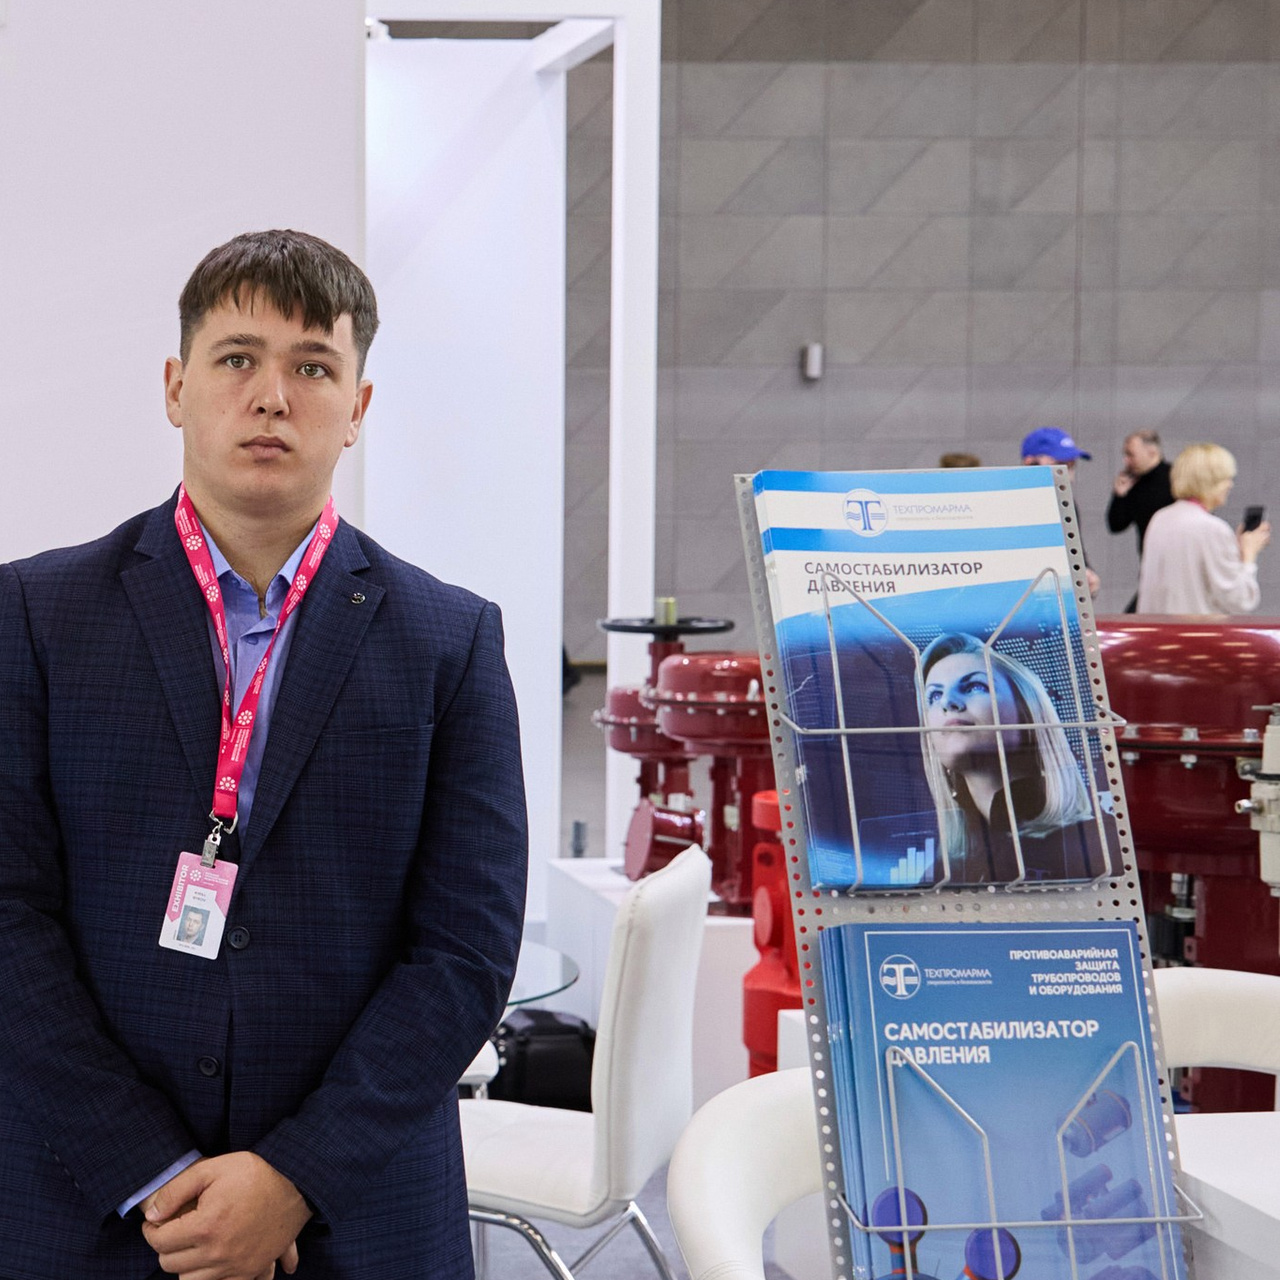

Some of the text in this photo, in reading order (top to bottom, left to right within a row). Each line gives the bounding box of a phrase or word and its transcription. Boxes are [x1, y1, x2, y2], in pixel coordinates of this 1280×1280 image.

[892, 504, 972, 515] ТЕХПРОМАРМА
[804, 562, 983, 577] САМОСТАБИЛИЗАТОР
[172, 865, 189, 913] EXHIBITOR
[1009, 946, 1119, 960] ПРОТИВОАВАРИЙНАЯ
[1075, 960, 1120, 971] ЗАЩИТА
[923, 968, 992, 979] ТЕХПРОМАРМА
[1031, 972, 1122, 984] ТРУБОПРОВОДОВ
[1028, 984, 1123, 996] И ОБОРУДОВАНИЯ
[884, 1020, 1100, 1041] САМОСТАБИЛИЗАТОР
